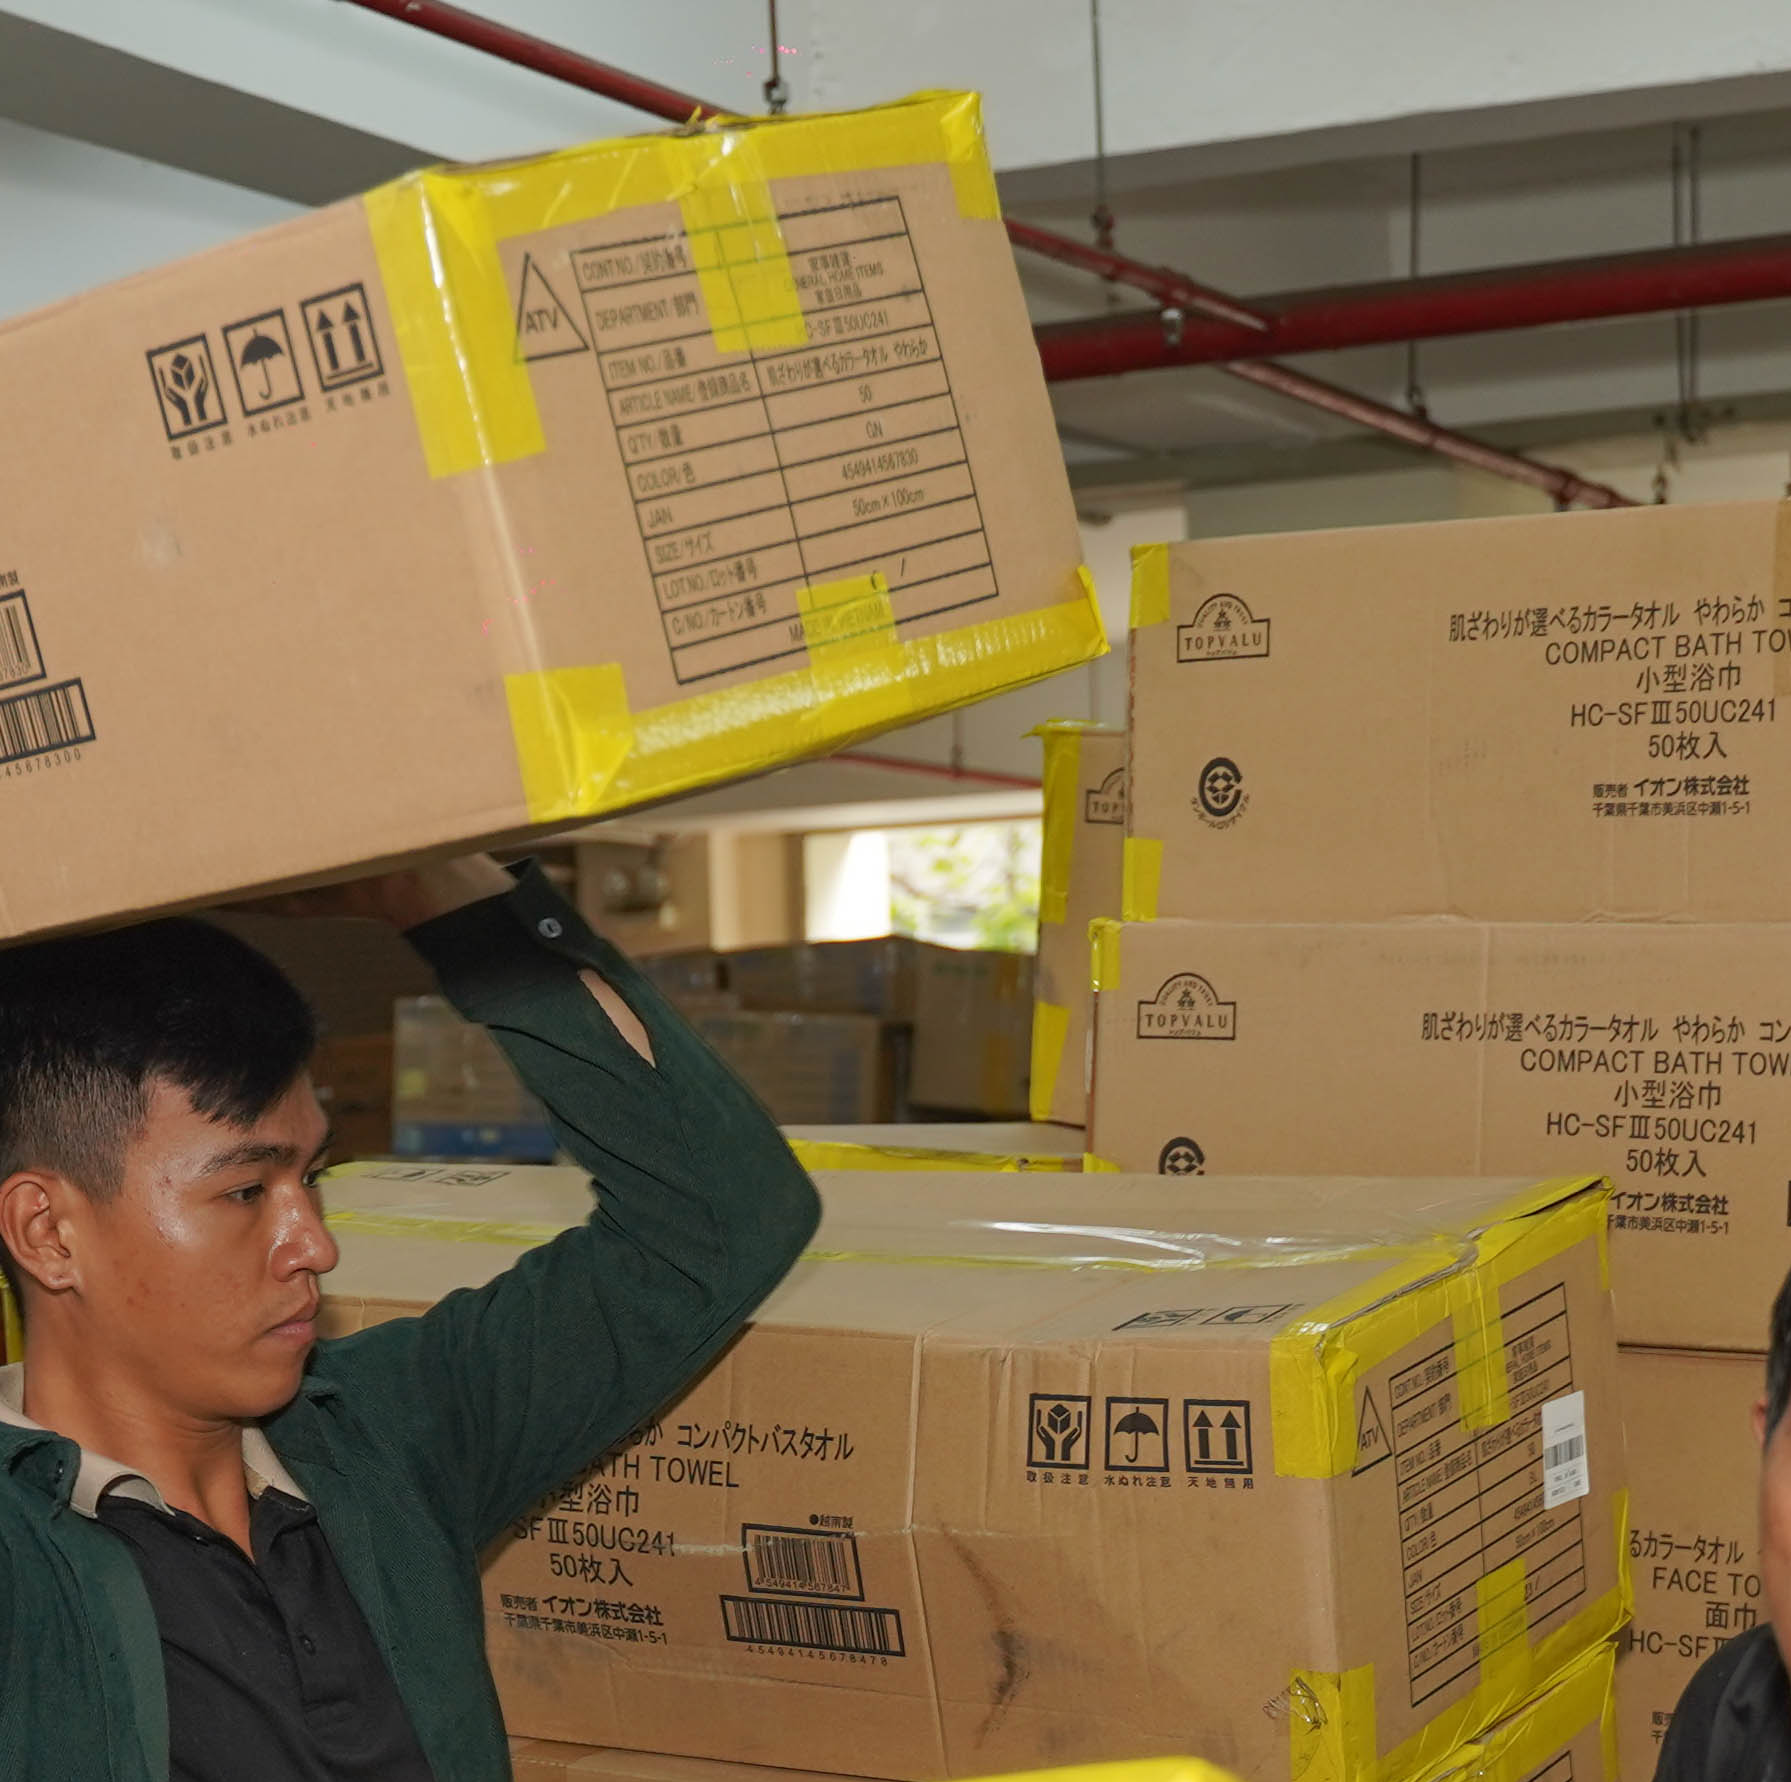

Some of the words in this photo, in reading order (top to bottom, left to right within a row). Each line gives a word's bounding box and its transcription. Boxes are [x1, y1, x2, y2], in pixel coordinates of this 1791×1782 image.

[525, 307, 560, 334] ATV
[647, 506, 673, 528] JAN
[1693, 596, 1765, 628] やわらか
[1184, 632, 1262, 651] TOPVALU
[1545, 636, 1666, 666] COMPACT
[1675, 631, 1743, 658] BATH
[1636, 661, 1742, 695] 小型浴巾
[1648, 731, 1728, 760] 50枚入
[1633, 773, 1750, 799] イオン株式会社
[1144, 1014, 1228, 1029] TOPVALU
[1673, 1015, 1745, 1045] やわらか
[1520, 1050, 1645, 1075] COMPACT
[1653, 1051, 1723, 1076] BATH
[1613, 1080, 1723, 1110] 小型浴巾
[1625, 1149, 1707, 1178] 50枚入
[1611, 1191, 1729, 1216] イオン株式会社
[677, 1422, 855, 1462] コンパクトバスタオル
[651, 1457, 740, 1489] TOWEL
[550, 1552, 634, 1587] 50枚入
[1652, 1567, 1718, 1594] FACE
[541, 1595, 665, 1627] イオン株式会社
[1705, 1601, 1757, 1630] 面巾
